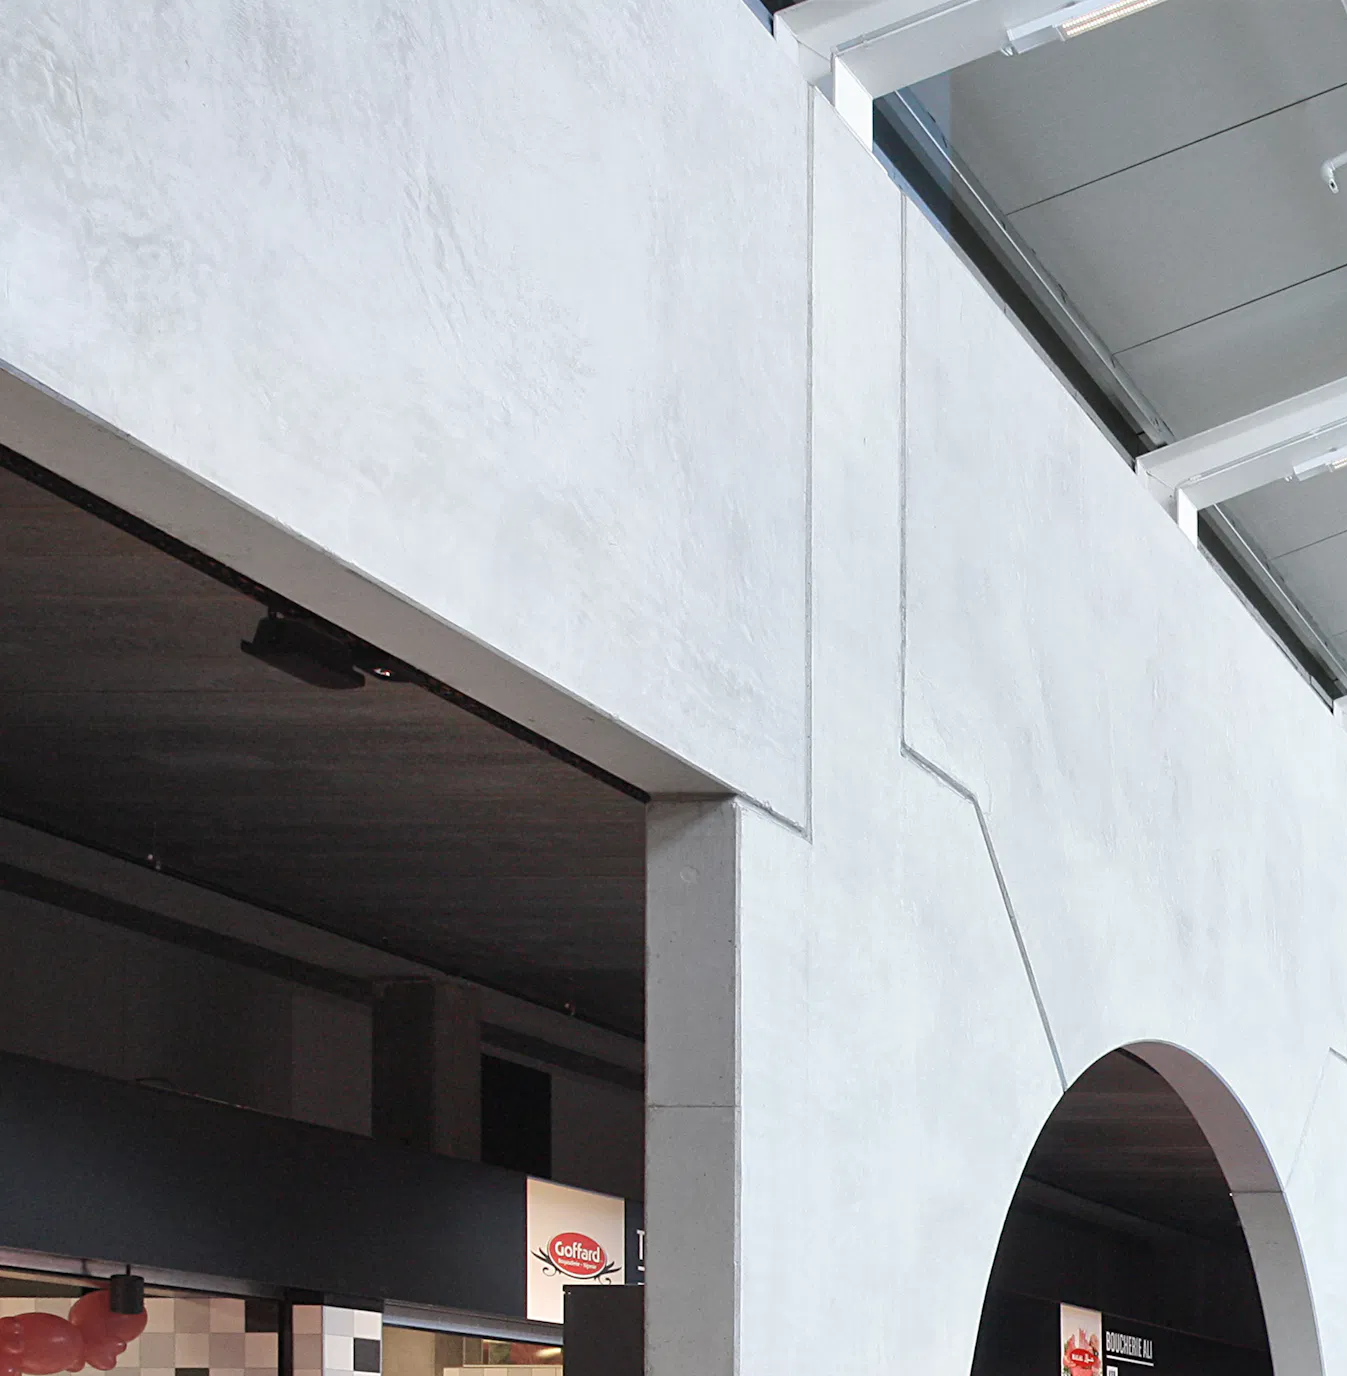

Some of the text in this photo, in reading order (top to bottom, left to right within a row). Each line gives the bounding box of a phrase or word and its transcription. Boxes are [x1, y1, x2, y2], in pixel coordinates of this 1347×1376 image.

[554, 1240, 600, 1263] Goffard
[1105, 1331, 1153, 1359] BOUCHERIE ALI
